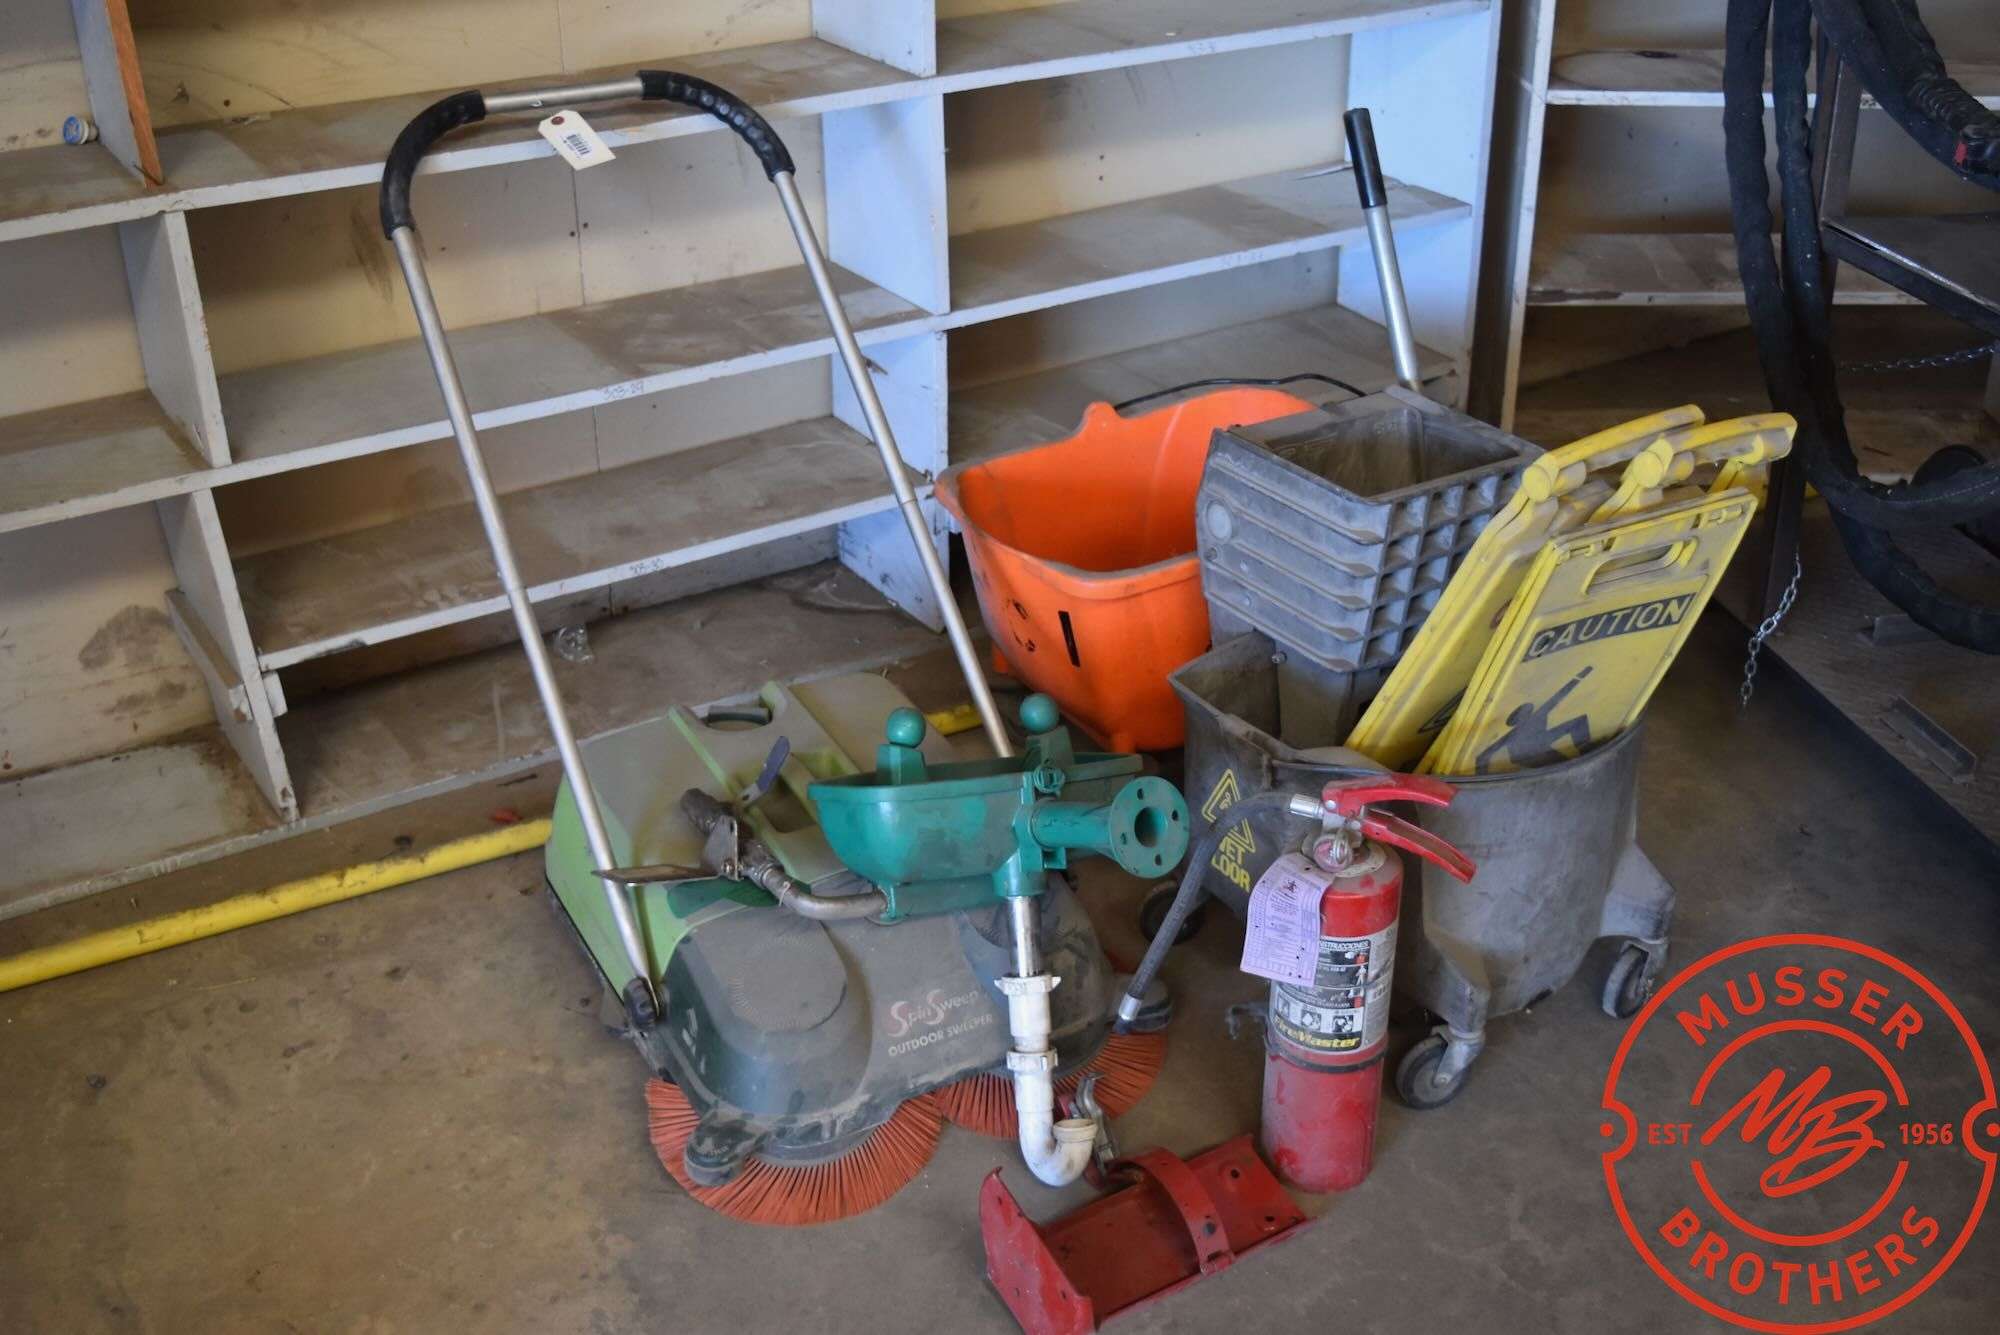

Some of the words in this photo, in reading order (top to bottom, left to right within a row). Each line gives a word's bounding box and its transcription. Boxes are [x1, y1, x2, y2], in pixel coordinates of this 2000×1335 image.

[1527, 596, 1691, 658] CAUTION
[888, 1031, 944, 1057] OUTDOOR
[946, 1013, 993, 1038] SWEEPER
